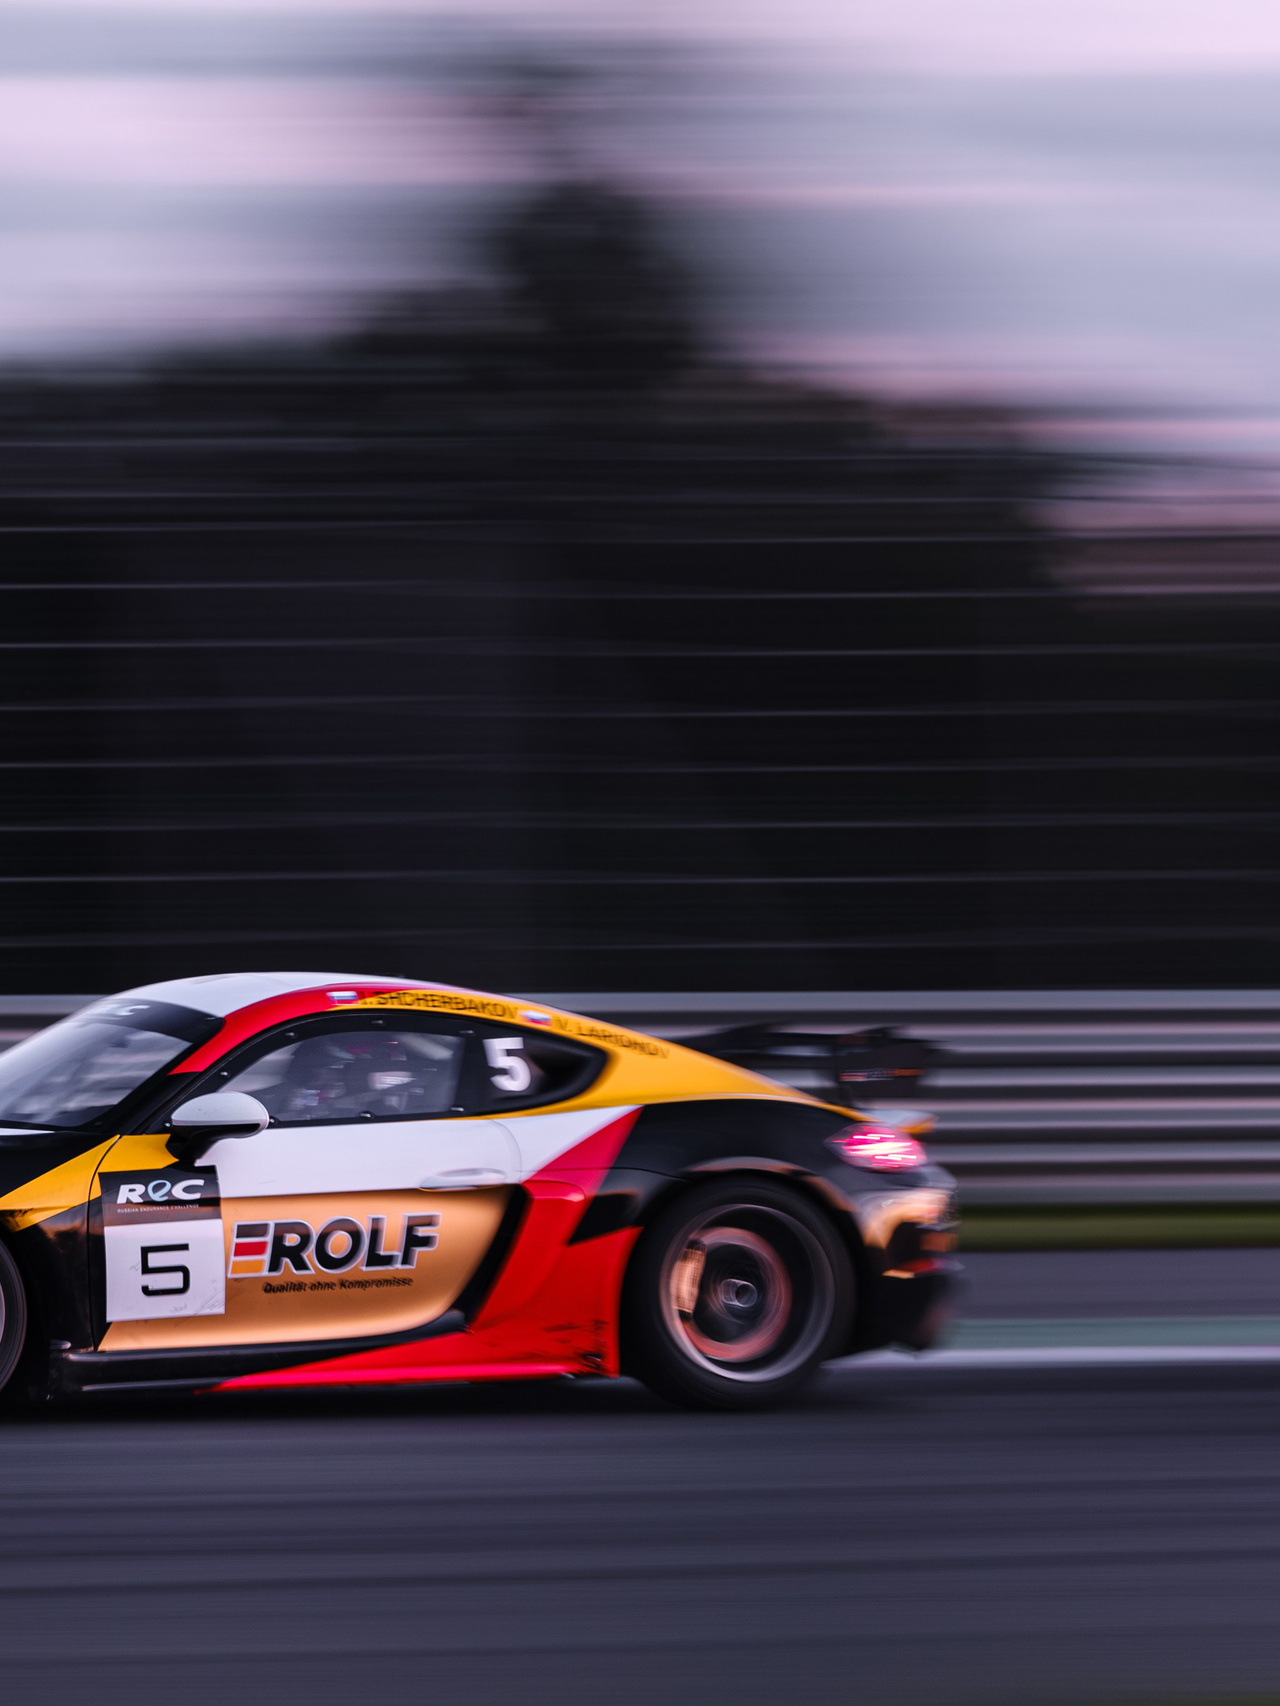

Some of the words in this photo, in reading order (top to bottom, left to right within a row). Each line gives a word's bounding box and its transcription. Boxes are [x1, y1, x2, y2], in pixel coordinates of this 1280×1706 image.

[482, 1036, 532, 1092] 5
[140, 1243, 191, 1297] 5
[267, 1212, 442, 1276] ROLF
[309, 1279, 337, 1292] ohne
[339, 1276, 414, 1291] Kompromisse
